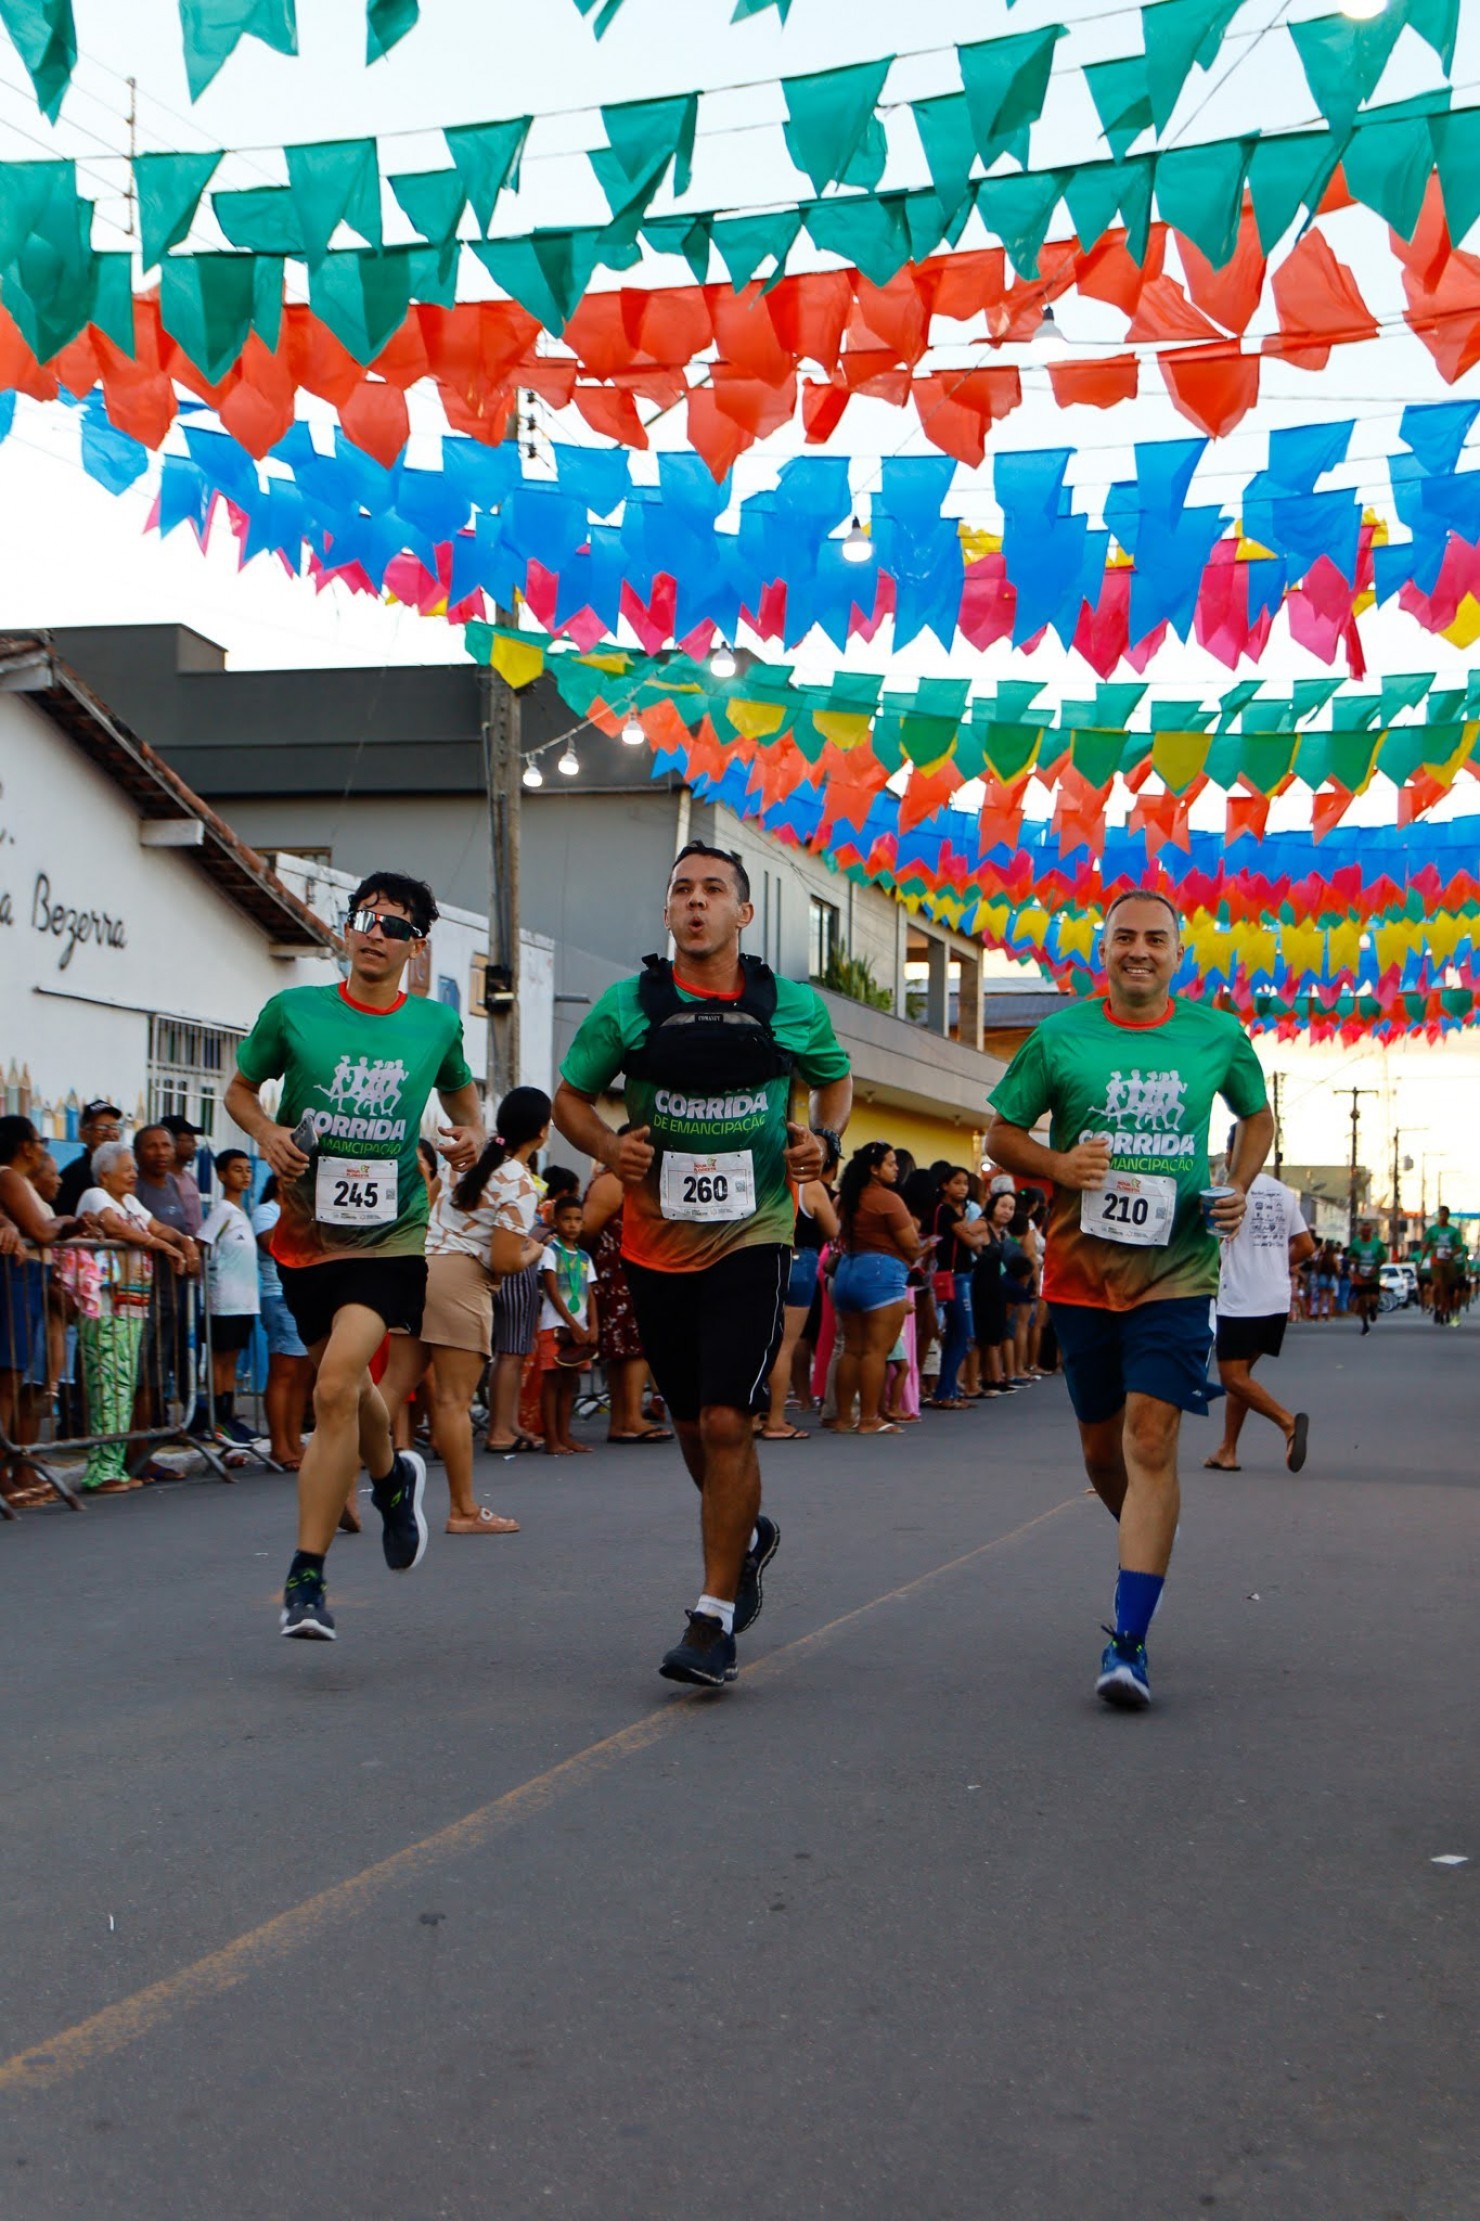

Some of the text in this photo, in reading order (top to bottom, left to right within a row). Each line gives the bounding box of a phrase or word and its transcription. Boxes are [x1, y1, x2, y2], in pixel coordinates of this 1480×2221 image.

[31, 873, 126, 970] Bezerra
[655, 1089, 769, 1119] CORRIDA
[653, 1114, 668, 1130] DE
[1109, 1157, 1193, 1172] MANCIPAÇÃO
[333, 1181, 378, 1208] 245
[683, 1175, 728, 1203] 260
[1102, 1193, 1148, 1225] 210
